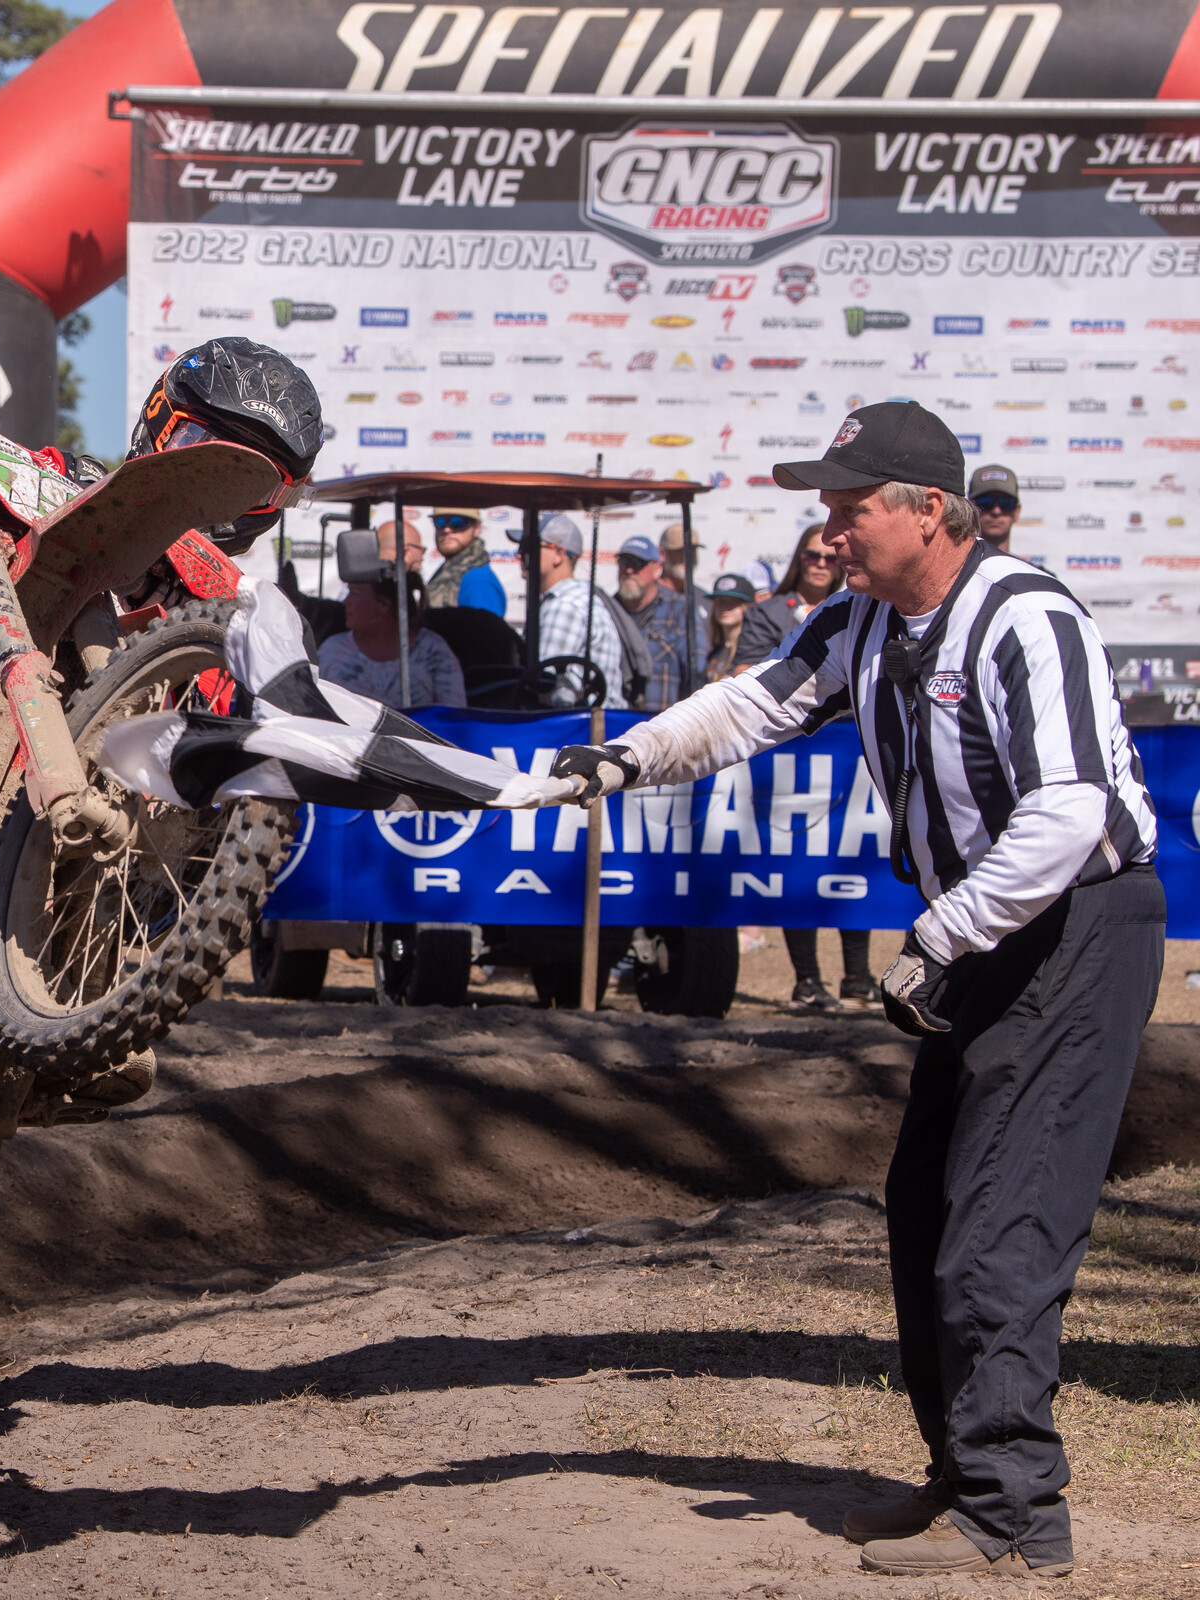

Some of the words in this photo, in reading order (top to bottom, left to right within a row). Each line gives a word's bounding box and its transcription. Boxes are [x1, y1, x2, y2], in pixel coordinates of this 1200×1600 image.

[337, 2, 1062, 98] SPECIALIZED
[160, 120, 360, 155] SPECIALIZED
[374, 125, 575, 168] VICTORY
[874, 132, 1075, 174] VICTORY
[397, 168, 524, 208] LANE
[599, 145, 824, 207] GNCC
[897, 175, 1028, 214] LANE
[1105, 177, 1200, 203] tur
[652, 205, 772, 231] RACING
[152, 228, 247, 266] 2022
[255, 230, 392, 269] GRAND
[399, 233, 597, 272] NATIONAL
[819, 239, 953, 277] CROSS
[958, 240, 1146, 278] COUNTRY
[249, 401, 285, 428] SHOEI
[927, 679, 966, 694] GNCC
[413, 868, 870, 900] RACING
